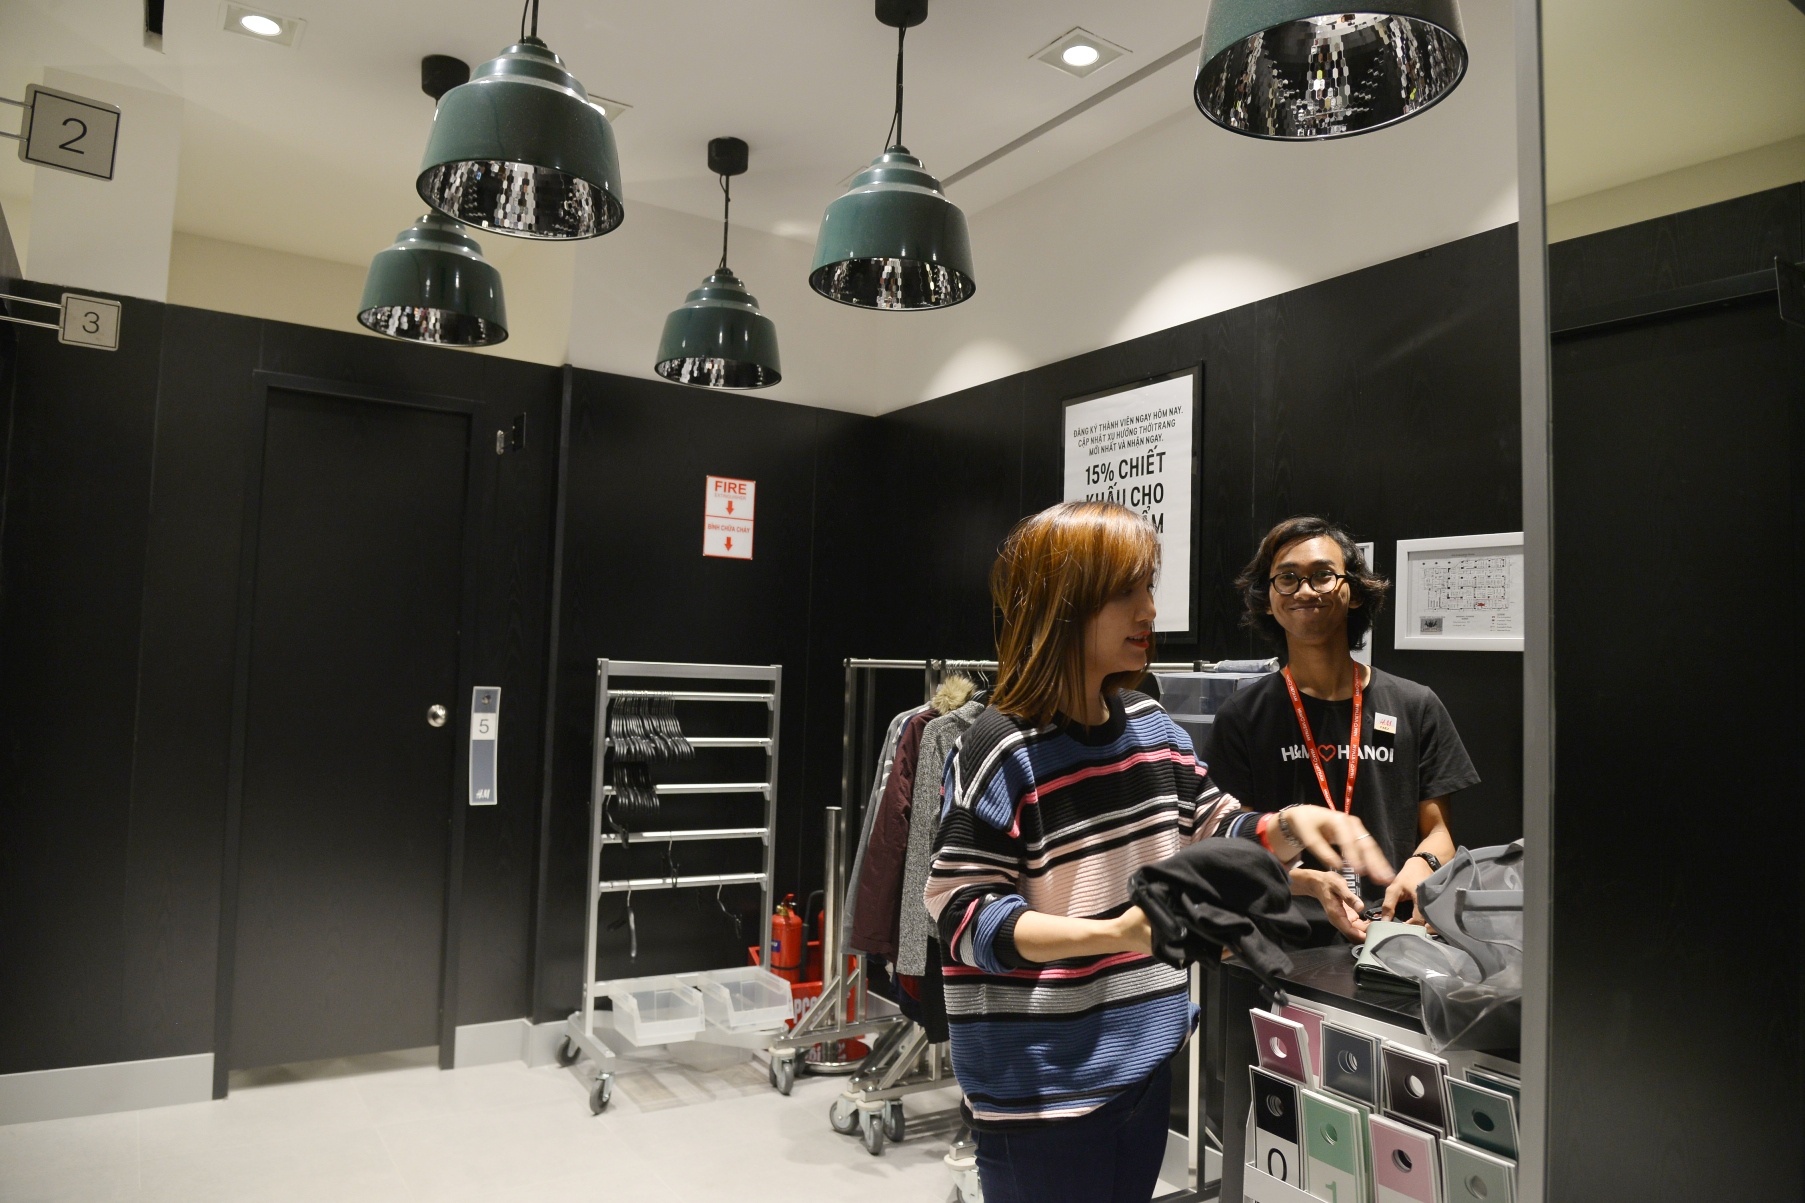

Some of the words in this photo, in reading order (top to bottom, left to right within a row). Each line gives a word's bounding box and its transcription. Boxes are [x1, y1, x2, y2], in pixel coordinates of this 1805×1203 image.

[58, 117, 88, 155] 2
[82, 311, 100, 334] 3
[1120, 416, 1135, 427] VIÊN
[1135, 413, 1152, 424] NGAY
[1153, 408, 1168, 420] HÔM
[1168, 405, 1184, 417] NAY.
[1154, 418, 1176, 431] TRANG
[1085, 462, 1115, 485] 15%
[1118, 445, 1166, 480] CHIẾT
[714, 480, 747, 495] FIRE
[1130, 482, 1164, 507] CHO
[479, 719, 489, 734] 5
[1281, 744, 1310, 762] H&M
[1267, 1147, 1287, 1182] 0
